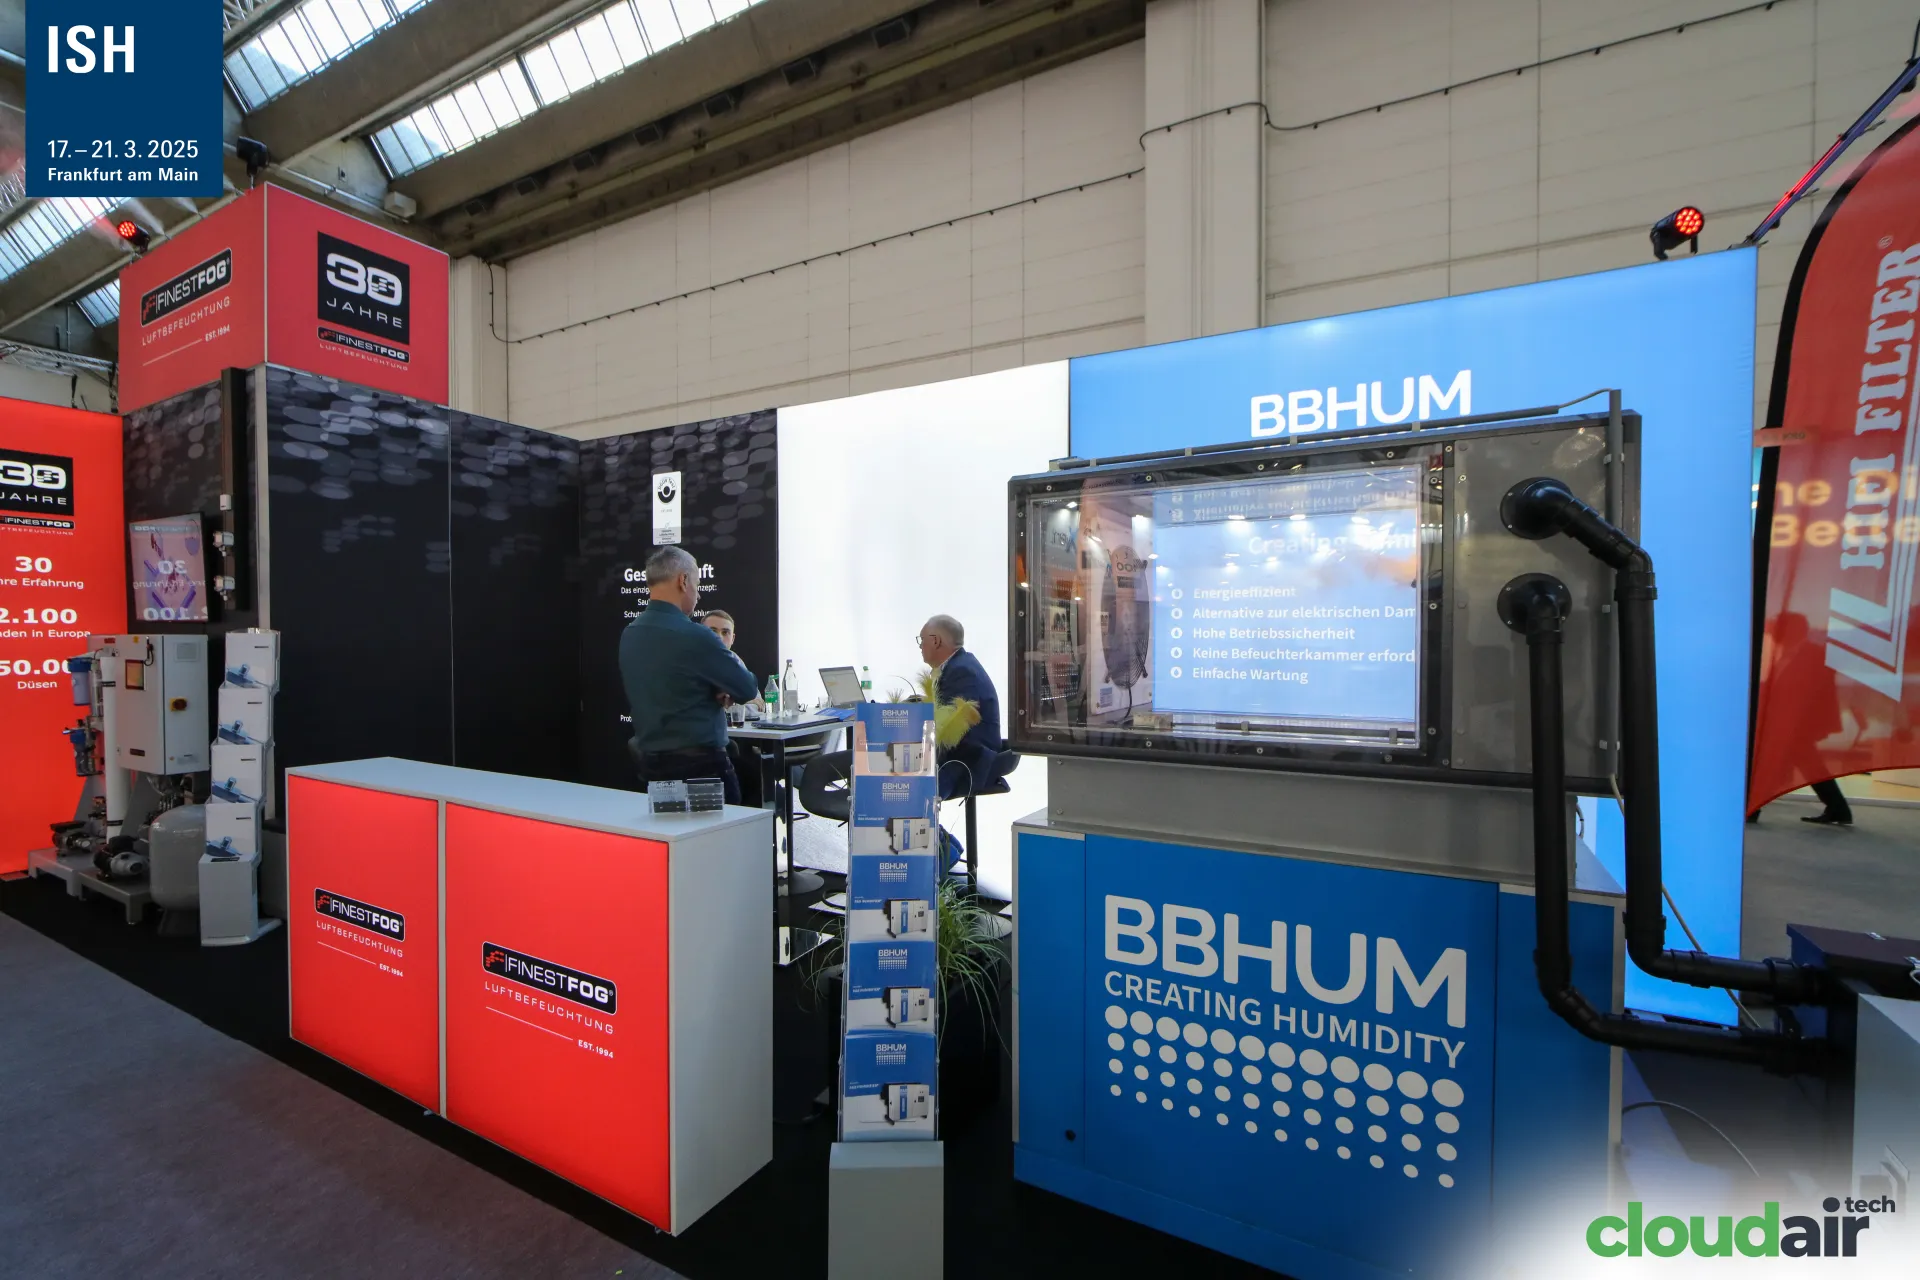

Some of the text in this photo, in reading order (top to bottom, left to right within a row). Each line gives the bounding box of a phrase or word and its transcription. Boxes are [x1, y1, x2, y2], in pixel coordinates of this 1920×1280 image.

[326, 252, 403, 307] 30
[142, 296, 230, 346] LUFTBEFEUCHTUNG
[326, 298, 403, 328] JAHRE
[1855, 243, 1920, 436] FILTER
[319, 343, 408, 371] LUFTBEFEUCHTUNG
[1251, 369, 1472, 438] BBHUM
[0, 459, 67, 490] 30
[15, 556, 52, 573] 30
[22, 577, 84, 590] Erfahrung
[621, 586, 632, 595] Das
[1193, 585, 1296, 601] Energieeffizient
[0, 606, 78, 624] 2.100
[1192, 606, 1264, 620] Alternative
[1267, 609, 1288, 619] zur
[1291, 605, 1380, 619] elektrischen
[0, 629, 91, 641] den in Europa
[1192, 627, 1356, 641] Hohe Betriebssicherheit
[1192, 648, 1228, 660] Keine
[1231, 648, 1365, 662] Befeuchterkammer
[17, 680, 58, 690] Düsen
[1192, 667, 1309, 685] Einfache Wartung
[882, 709, 909, 717] BBHUM
[882, 782, 910, 790] BBHUM
[879, 862, 908, 870] BBHUM
[332, 899, 400, 933] FINESTFOG
[316, 920, 403, 958] LUFTBEFEUCHTUNG
[878, 949, 908, 957] BBHUM
[1104, 894, 1467, 1028] BBHUM
[507, 956, 609, 1004] FINESTFOG
[484, 981, 614, 1035] LUFTBEFEUCHTUNG
[1104, 970, 1466, 1069] CREATING HUMIDITY
[876, 1043, 907, 1052] BBHUM
